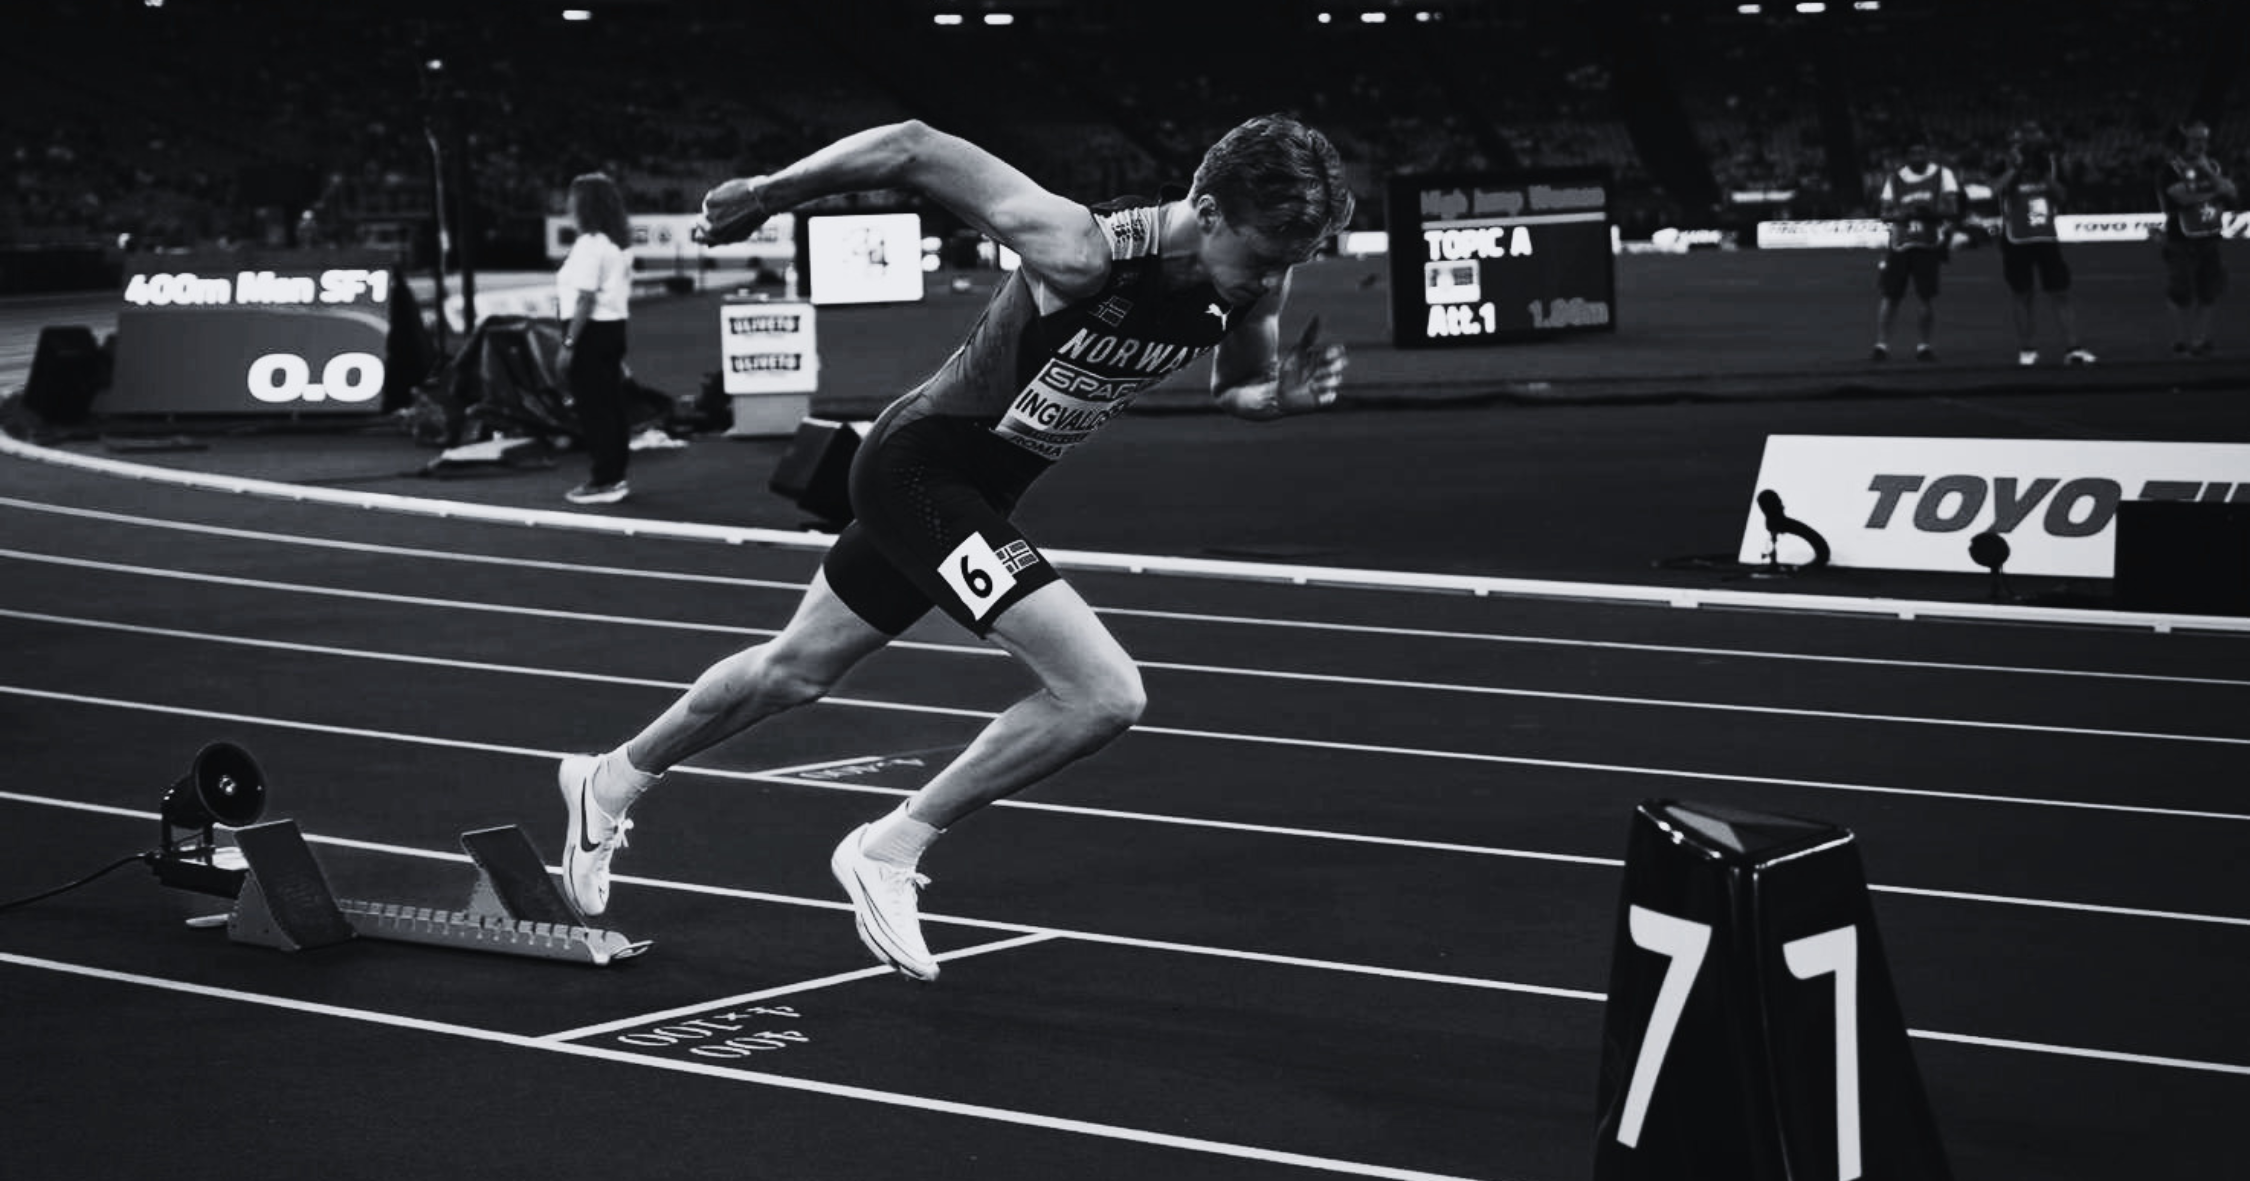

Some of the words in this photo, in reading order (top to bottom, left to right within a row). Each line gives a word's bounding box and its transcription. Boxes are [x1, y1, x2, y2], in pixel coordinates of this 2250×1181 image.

[1424, 227, 1504, 260] TOPIC
[1510, 226, 1532, 256] A
[124, 273, 231, 305] 400m
[236, 271, 315, 304] Men
[319, 269, 389, 303] SF1
[248, 352, 385, 402] 0.0
[1864, 474, 2122, 538] TOYO
[960, 555, 993, 598] 6
[1616, 904, 1712, 1149] 7
[1783, 924, 1862, 1181] 7
